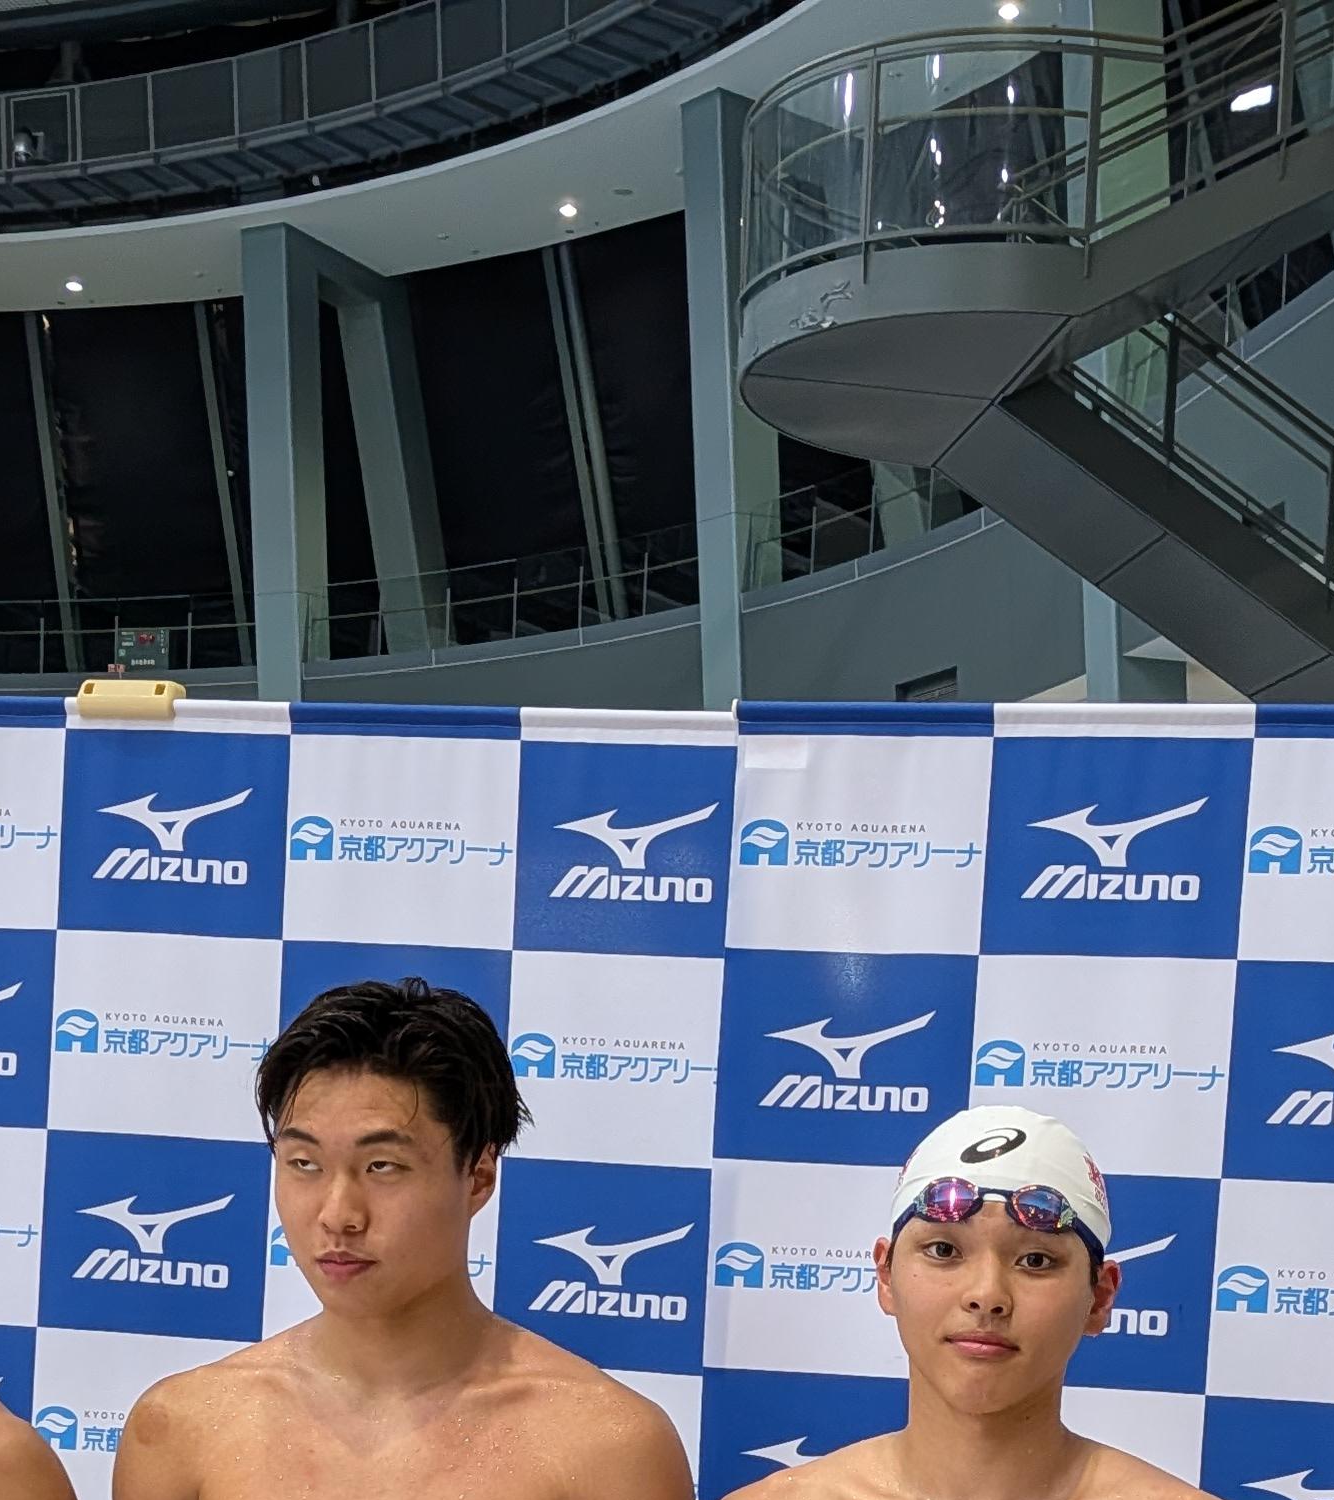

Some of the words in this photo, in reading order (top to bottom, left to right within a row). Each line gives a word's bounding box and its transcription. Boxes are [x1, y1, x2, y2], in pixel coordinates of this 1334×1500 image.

[340, 818, 384, 829] KYOTO
[390, 820, 462, 832] AQUARENA
[796, 822, 843, 833] KYOTO
[850, 823, 927, 834] AQUARENA
[338, 835, 514, 867] 京都アクアリーナ
[794, 839, 982, 869] 京都アクアリーナ
[92, 848, 247, 885] MIZUNO
[549, 865, 713, 904] MIZUNO
[1020, 865, 1200, 900] MIZUNO
[105, 1012, 148, 1024] KYOTO
[153, 1015, 225, 1027] AQUARENA
[562, 1035, 607, 1047] KYOTO
[614, 1038, 686, 1050] AQUARENA
[1033, 1043, 1081, 1053] KYOTO
[1088, 1043, 1168, 1055] AQUARENA
[560, 1053, 717, 1084] 京都アクアリー
[1031, 1060, 1225, 1092] 京都アクアリーナ
[758, 1074, 929, 1114] MIZUNO
[772, 1246, 818, 1257] KYOTO
[825, 1248, 875, 1260] AQUAR
[72, 1248, 229, 1289] MIZUNO
[770, 1263, 877, 1293] 京都アクア
[1277, 1270, 1328, 1281] KYOTO
[528, 1280, 688, 1321] MIZUNO
[84, 1410, 126, 1422] KYOTO
